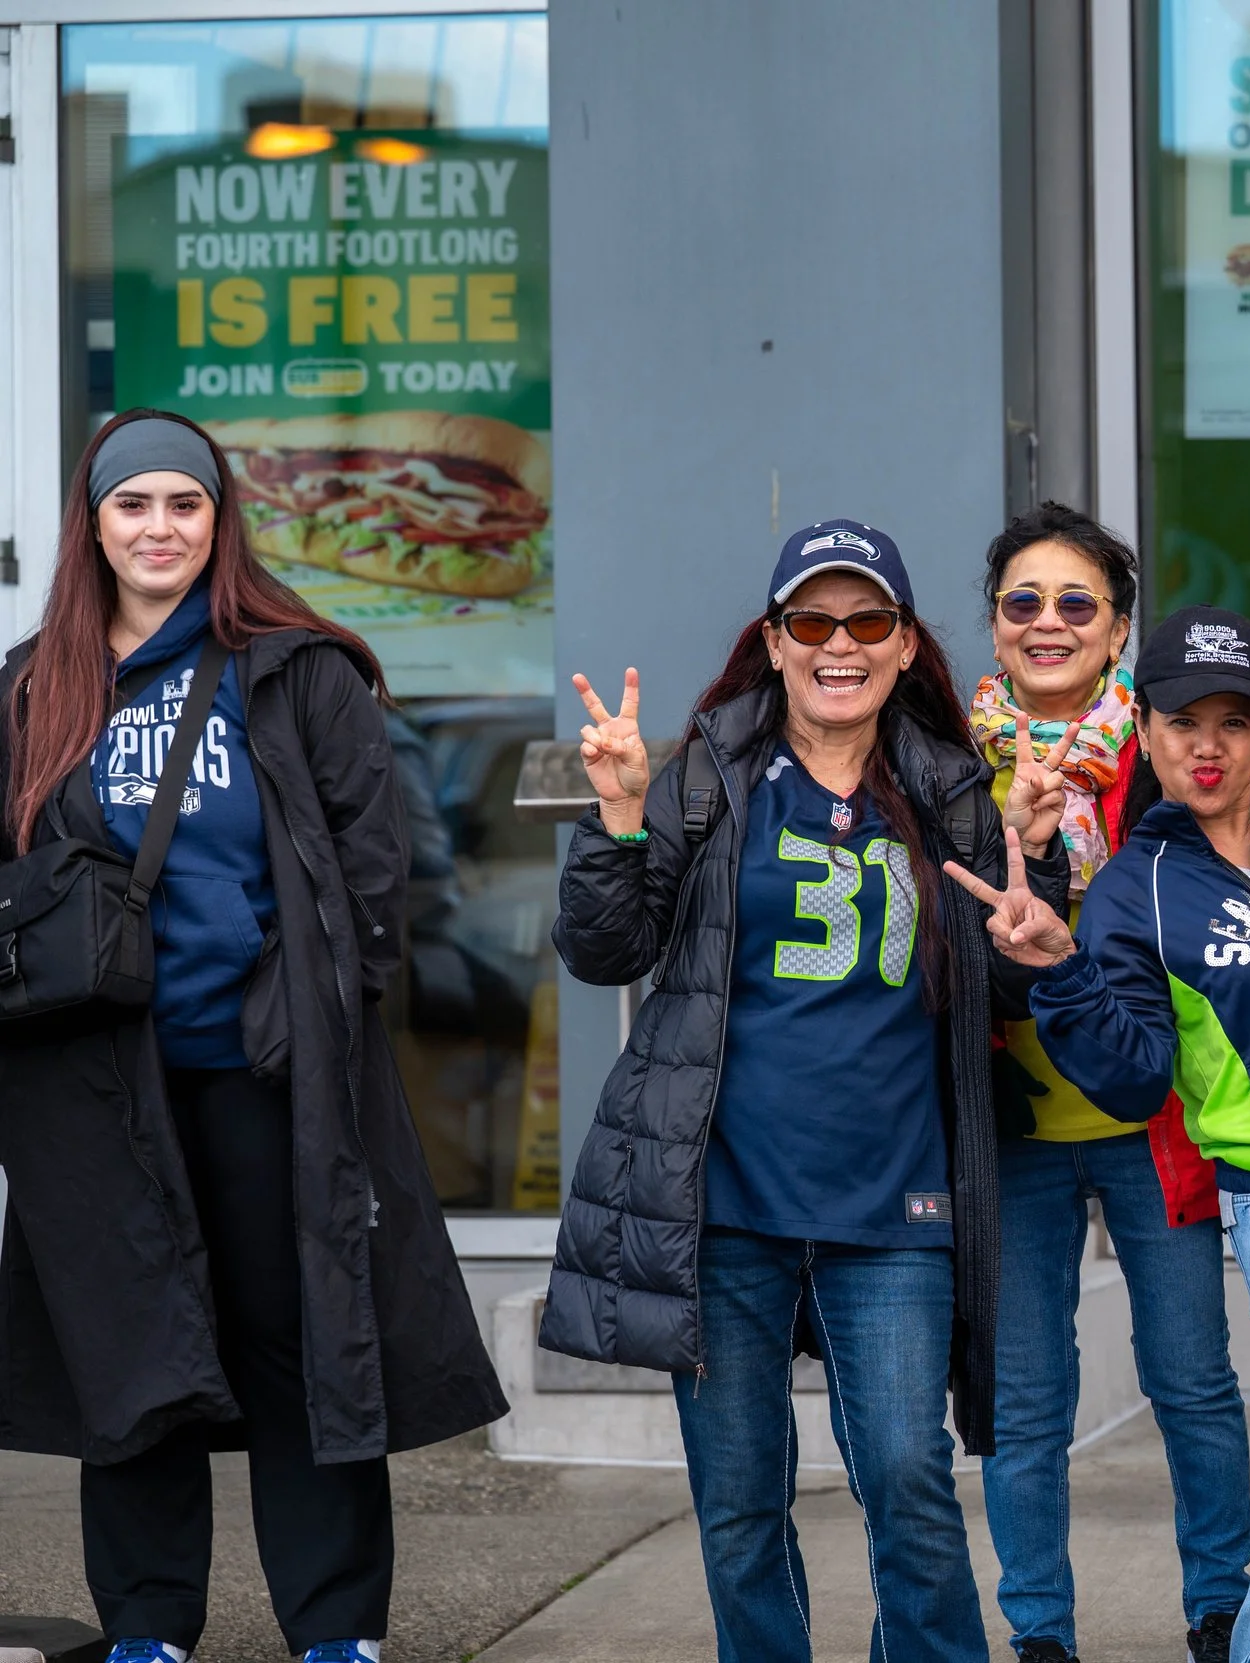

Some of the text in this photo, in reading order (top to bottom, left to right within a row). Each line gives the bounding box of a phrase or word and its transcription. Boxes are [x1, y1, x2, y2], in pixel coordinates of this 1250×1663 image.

[176, 159, 517, 224] NOW EVERY
[177, 228, 518, 270] FOURTH FOOTLONG
[177, 274, 518, 348] IS FREE
[178, 365, 272, 397] JOIN
[379, 361, 518, 393] TODAY
[110, 700, 183, 728] BOWL LX
[833, 813, 850, 828] NFL
[774, 827, 920, 988] 31
